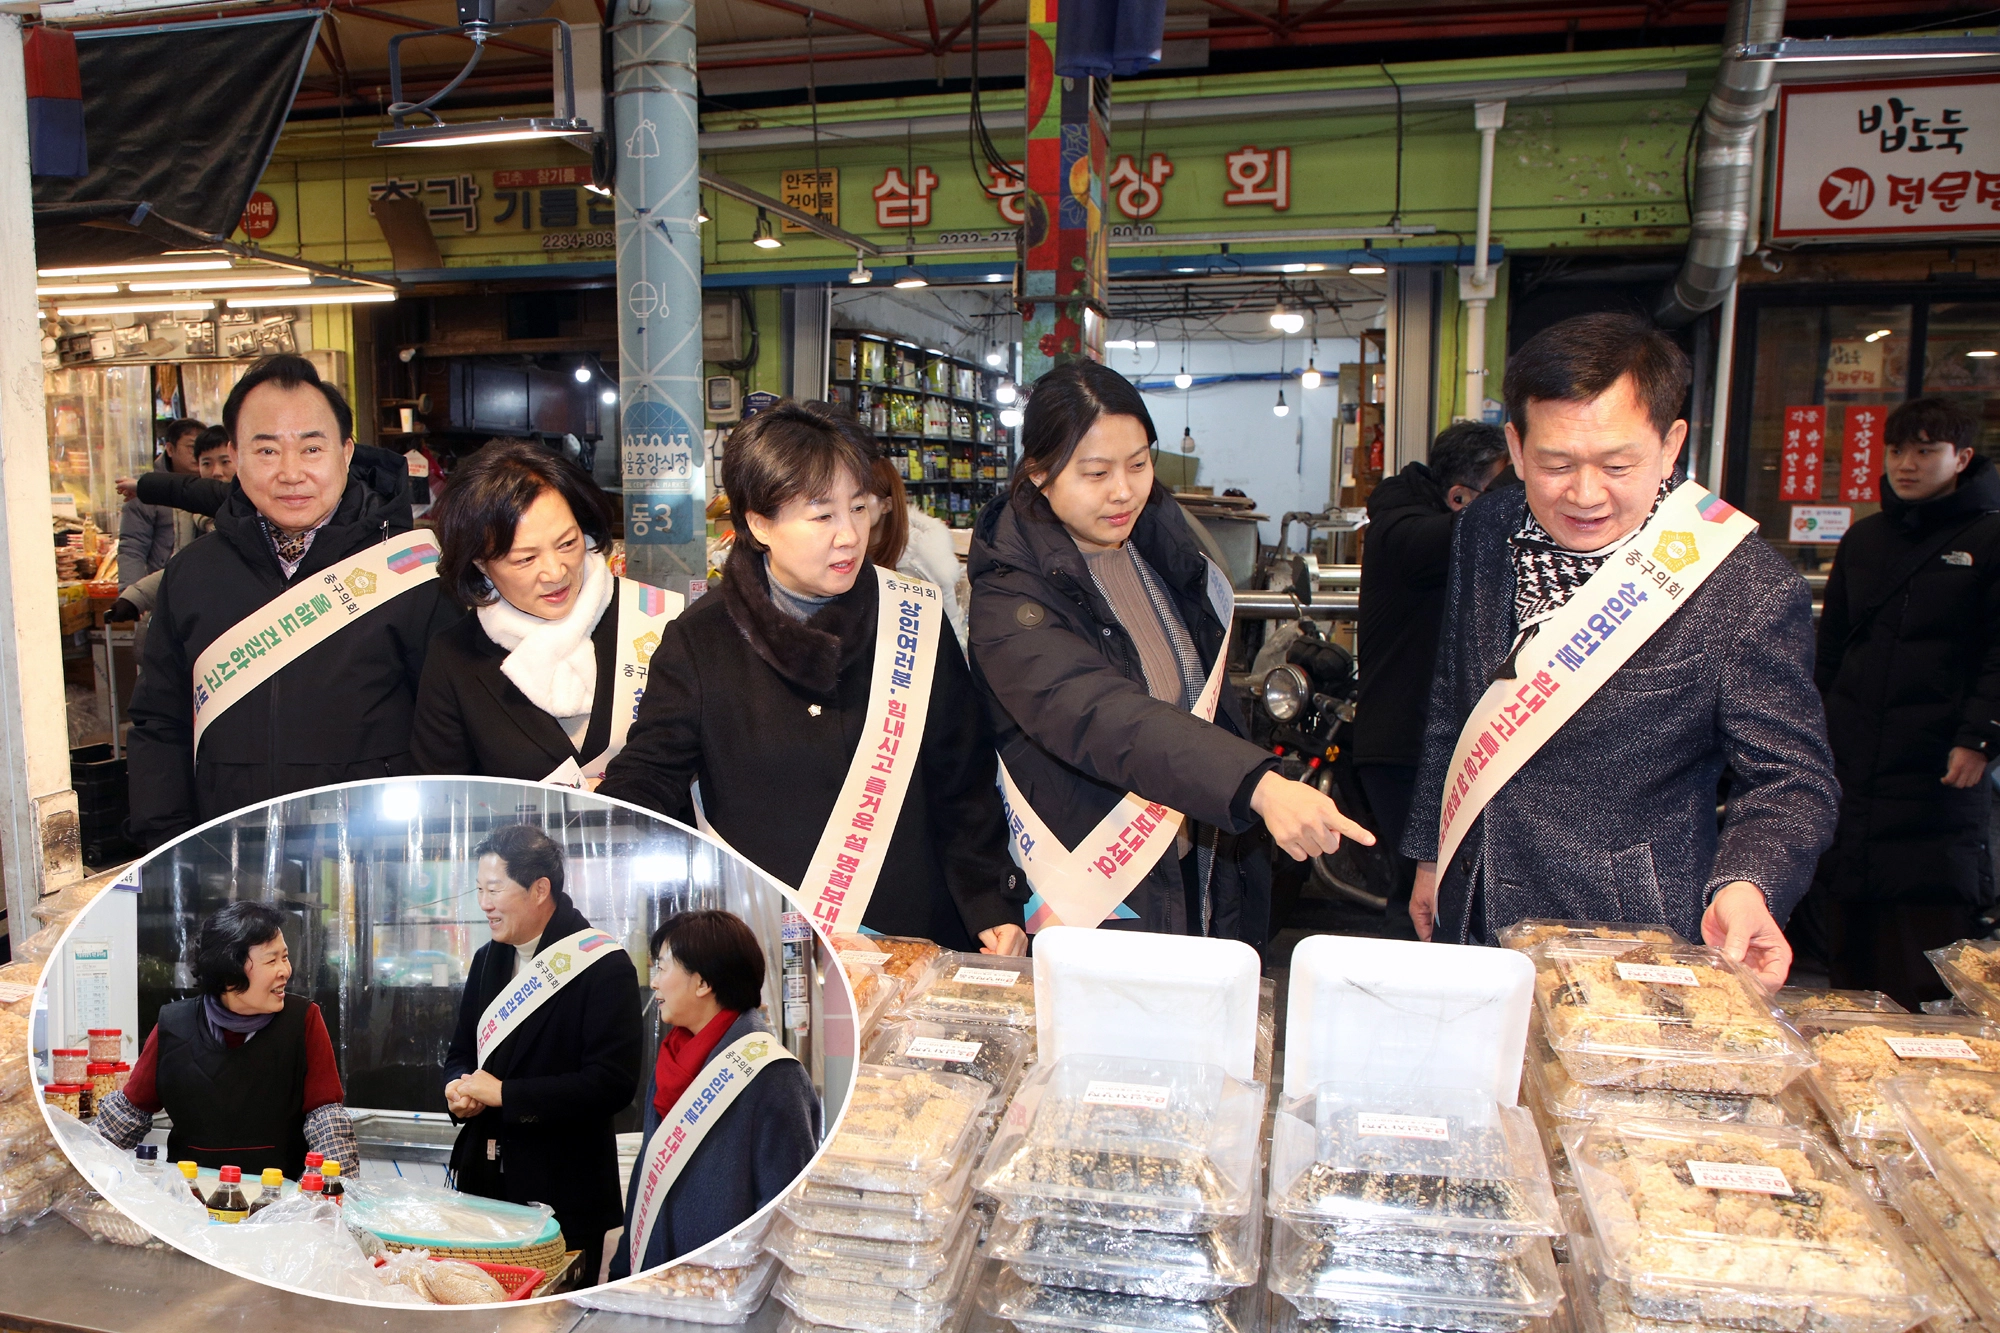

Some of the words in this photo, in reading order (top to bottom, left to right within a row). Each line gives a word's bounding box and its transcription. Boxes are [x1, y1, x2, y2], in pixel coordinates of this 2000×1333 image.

[1858, 97, 1969, 155] 밥도둑
[785, 172, 834, 190] 안주류
[541, 231, 616, 249] 2234-803
[622, 452, 690, 477] 울중앙시장
[630, 502, 673, 537] 동3
[323, 572, 361, 617] 중구의회
[885, 577, 938, 601] 중구의회
[1623, 548, 1686, 601] 중구의회
[277, 593, 333, 638] 올해도
[203, 625, 283, 694] 건강하시고
[1489, 669, 1562, 743] 힘내시고
[871, 698, 908, 775] 힘내시고
[851, 775, 887, 832] 즐거운
[843, 833, 869, 853] 설
[534, 959, 561, 990] 중구의회
[725, 1049, 755, 1078] 중구의회
[651, 1124, 687, 1176] 힘내시고
